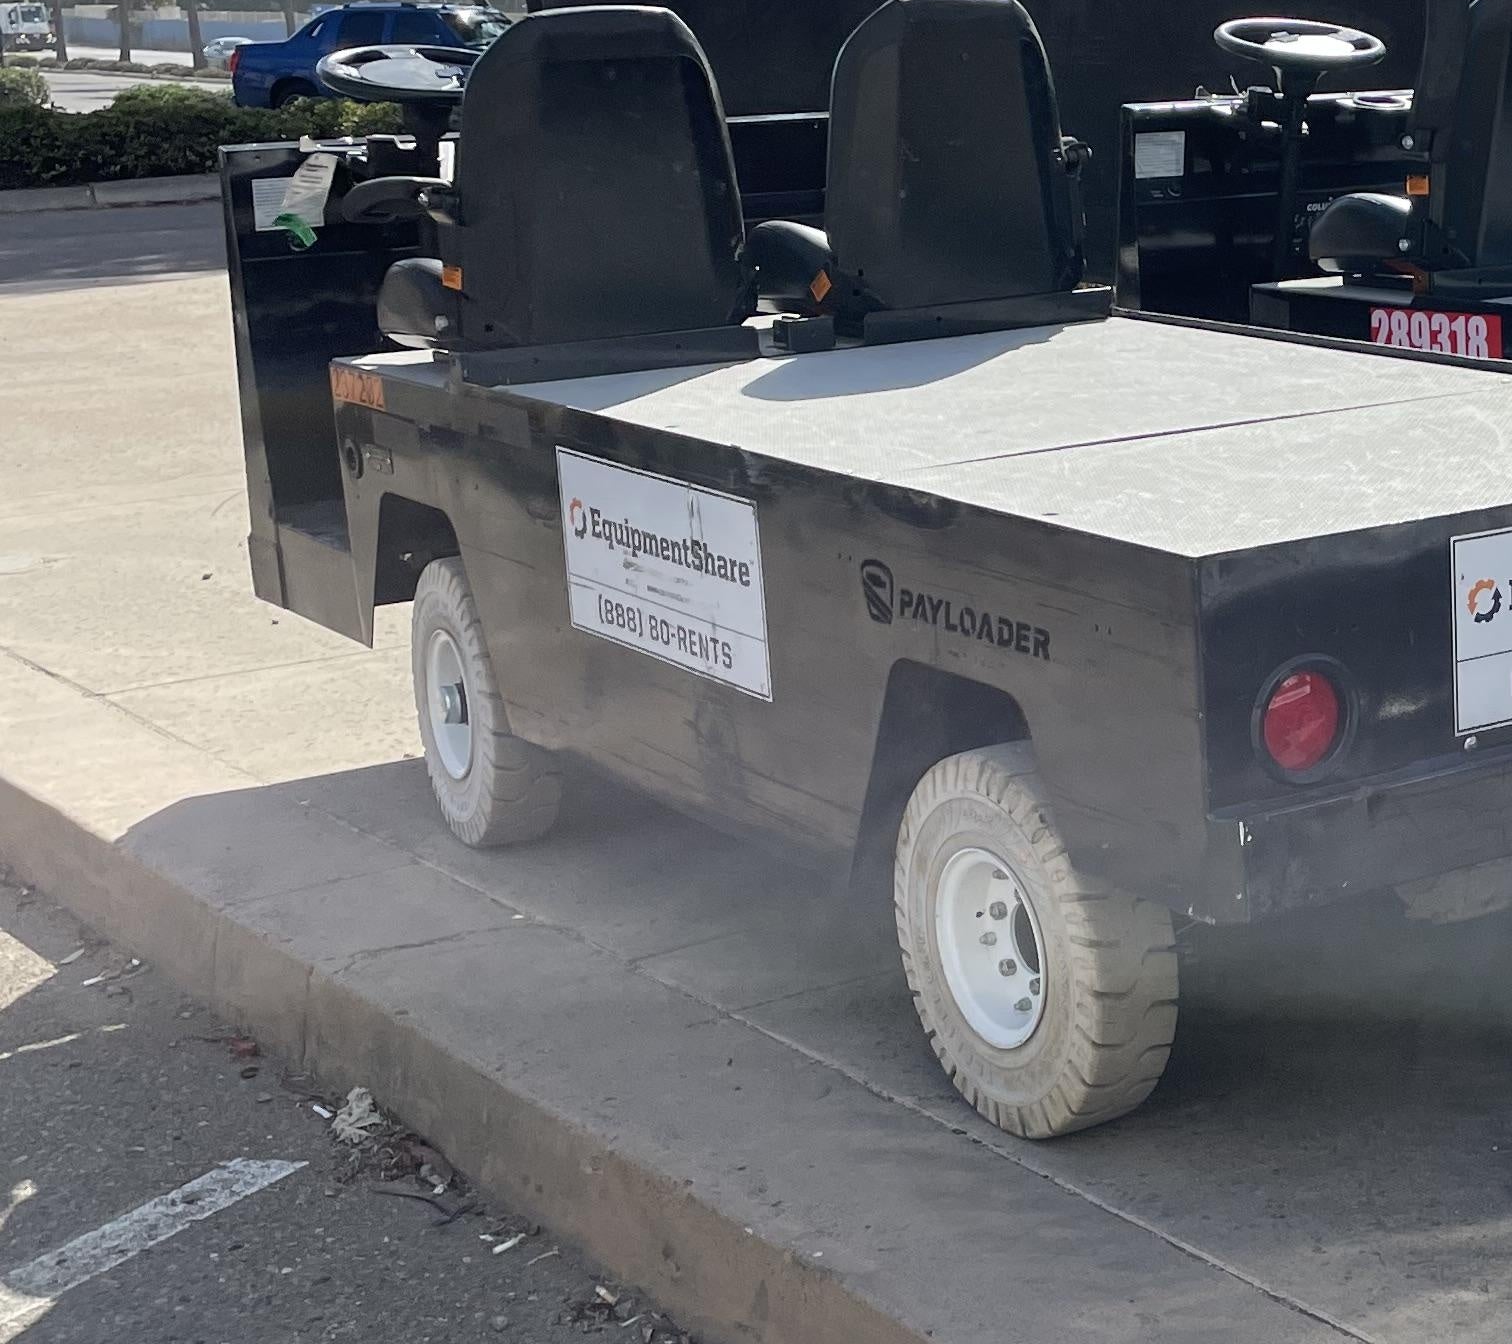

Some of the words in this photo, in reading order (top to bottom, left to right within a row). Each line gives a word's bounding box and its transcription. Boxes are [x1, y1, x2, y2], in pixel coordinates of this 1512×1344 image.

[1370, 308, 1489, 359] 289318
[590, 507, 751, 588] EquipmentShare
[598, 593, 644, 638] (888)
[648, 613, 733, 669] 80-RENTS
[899, 588, 1051, 661] PAYLOADER
